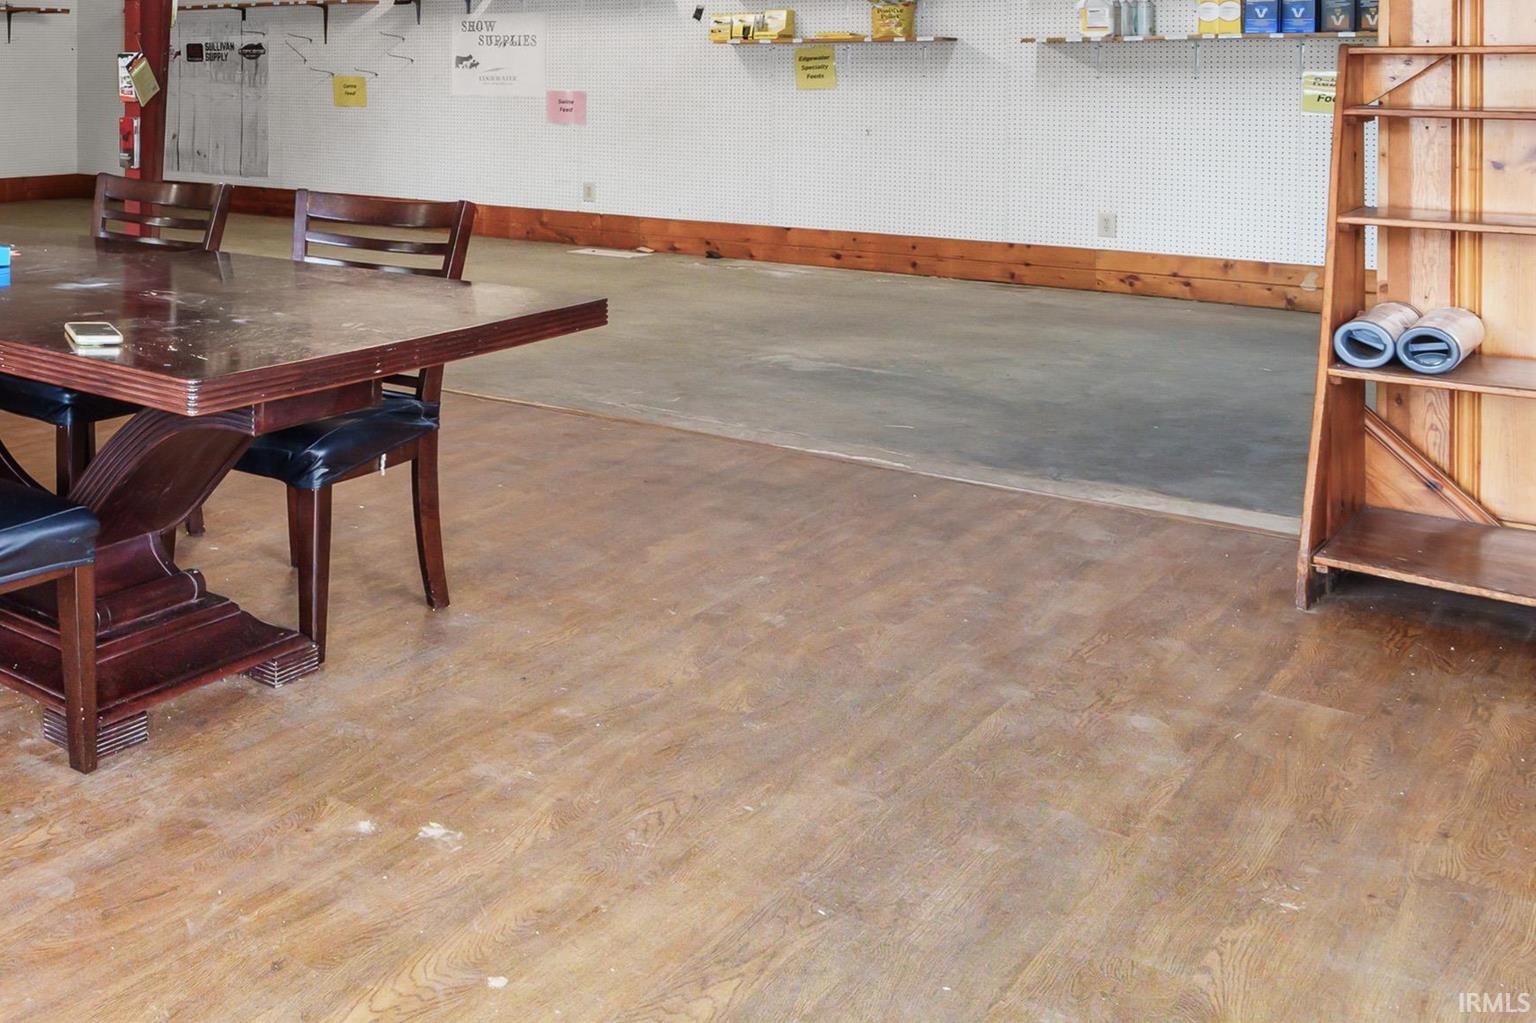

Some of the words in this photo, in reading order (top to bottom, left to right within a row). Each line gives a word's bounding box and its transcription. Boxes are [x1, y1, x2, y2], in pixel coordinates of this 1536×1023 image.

[461, 20, 497, 32] SHOW
[478, 35, 537, 47] SUPPLIES
[205, 42, 234, 51] SULLIVAN
[205, 52, 228, 61] SUPPLY
